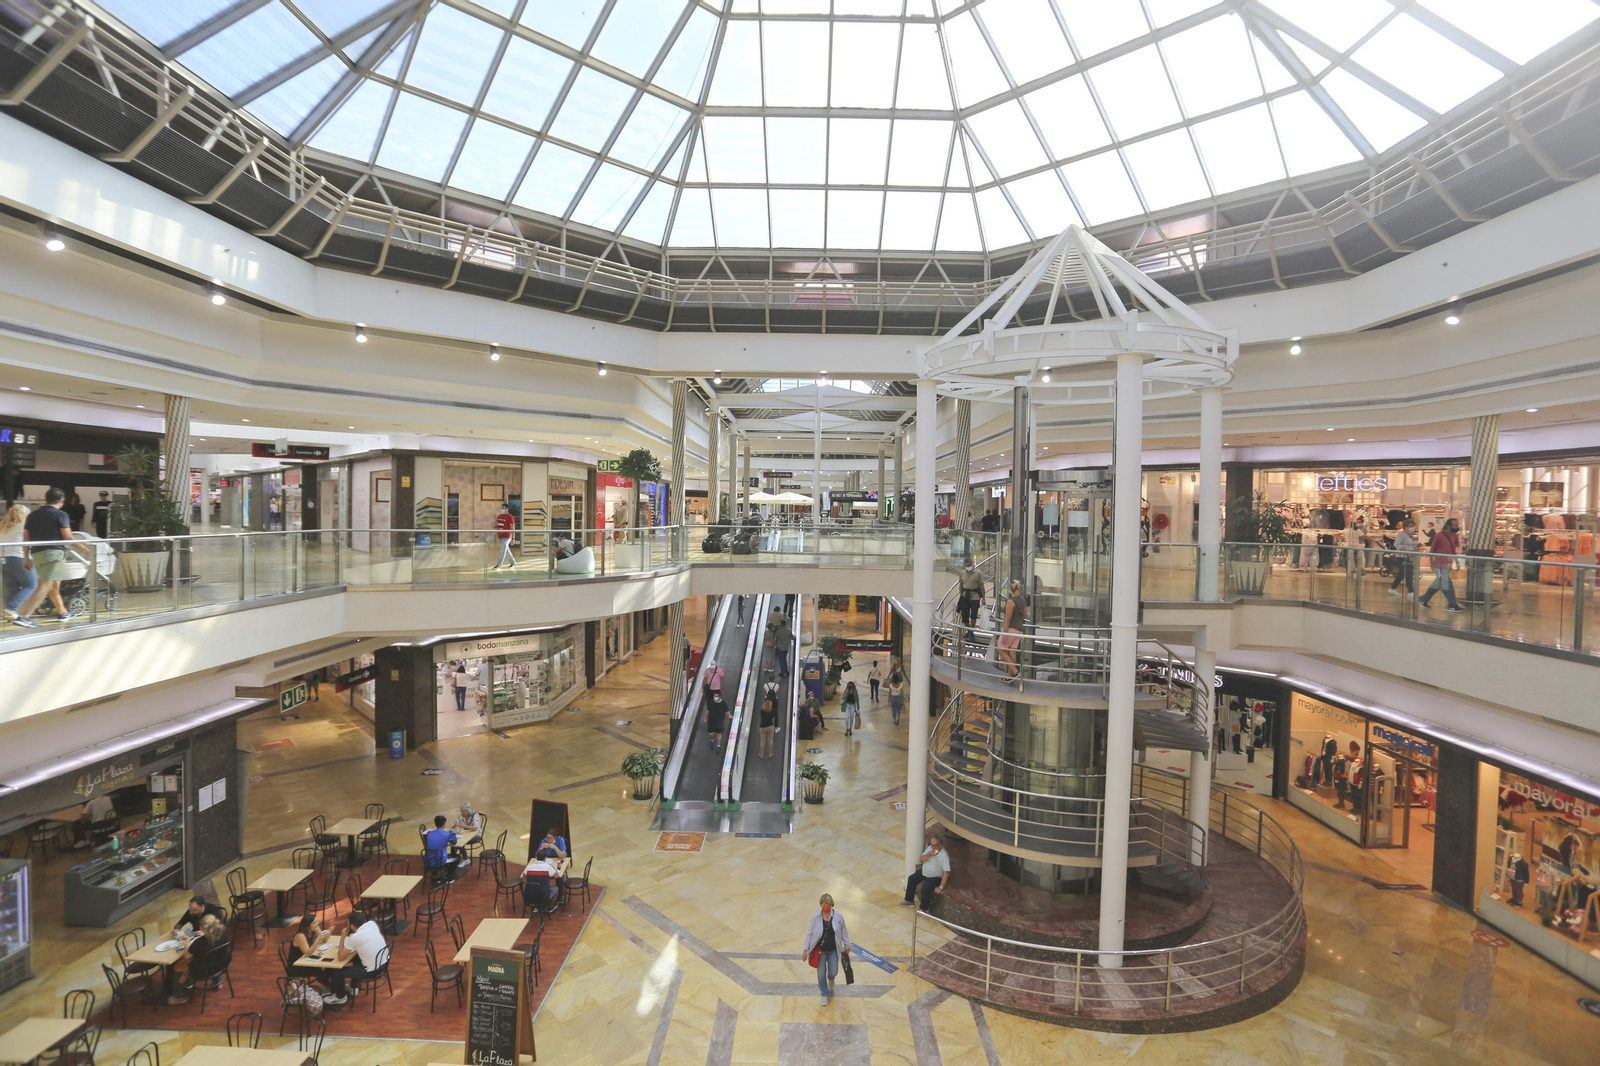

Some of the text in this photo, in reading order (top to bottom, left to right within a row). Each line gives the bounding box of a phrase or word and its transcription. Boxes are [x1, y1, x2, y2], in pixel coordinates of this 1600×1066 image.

[1314, 473, 1388, 492] lefties
[477, 639, 529, 650] todomanzana
[1297, 698, 1358, 728] mayoral.com
[1373, 725, 1432, 757] mayoral
[488, 966, 505, 974] MAGNA
